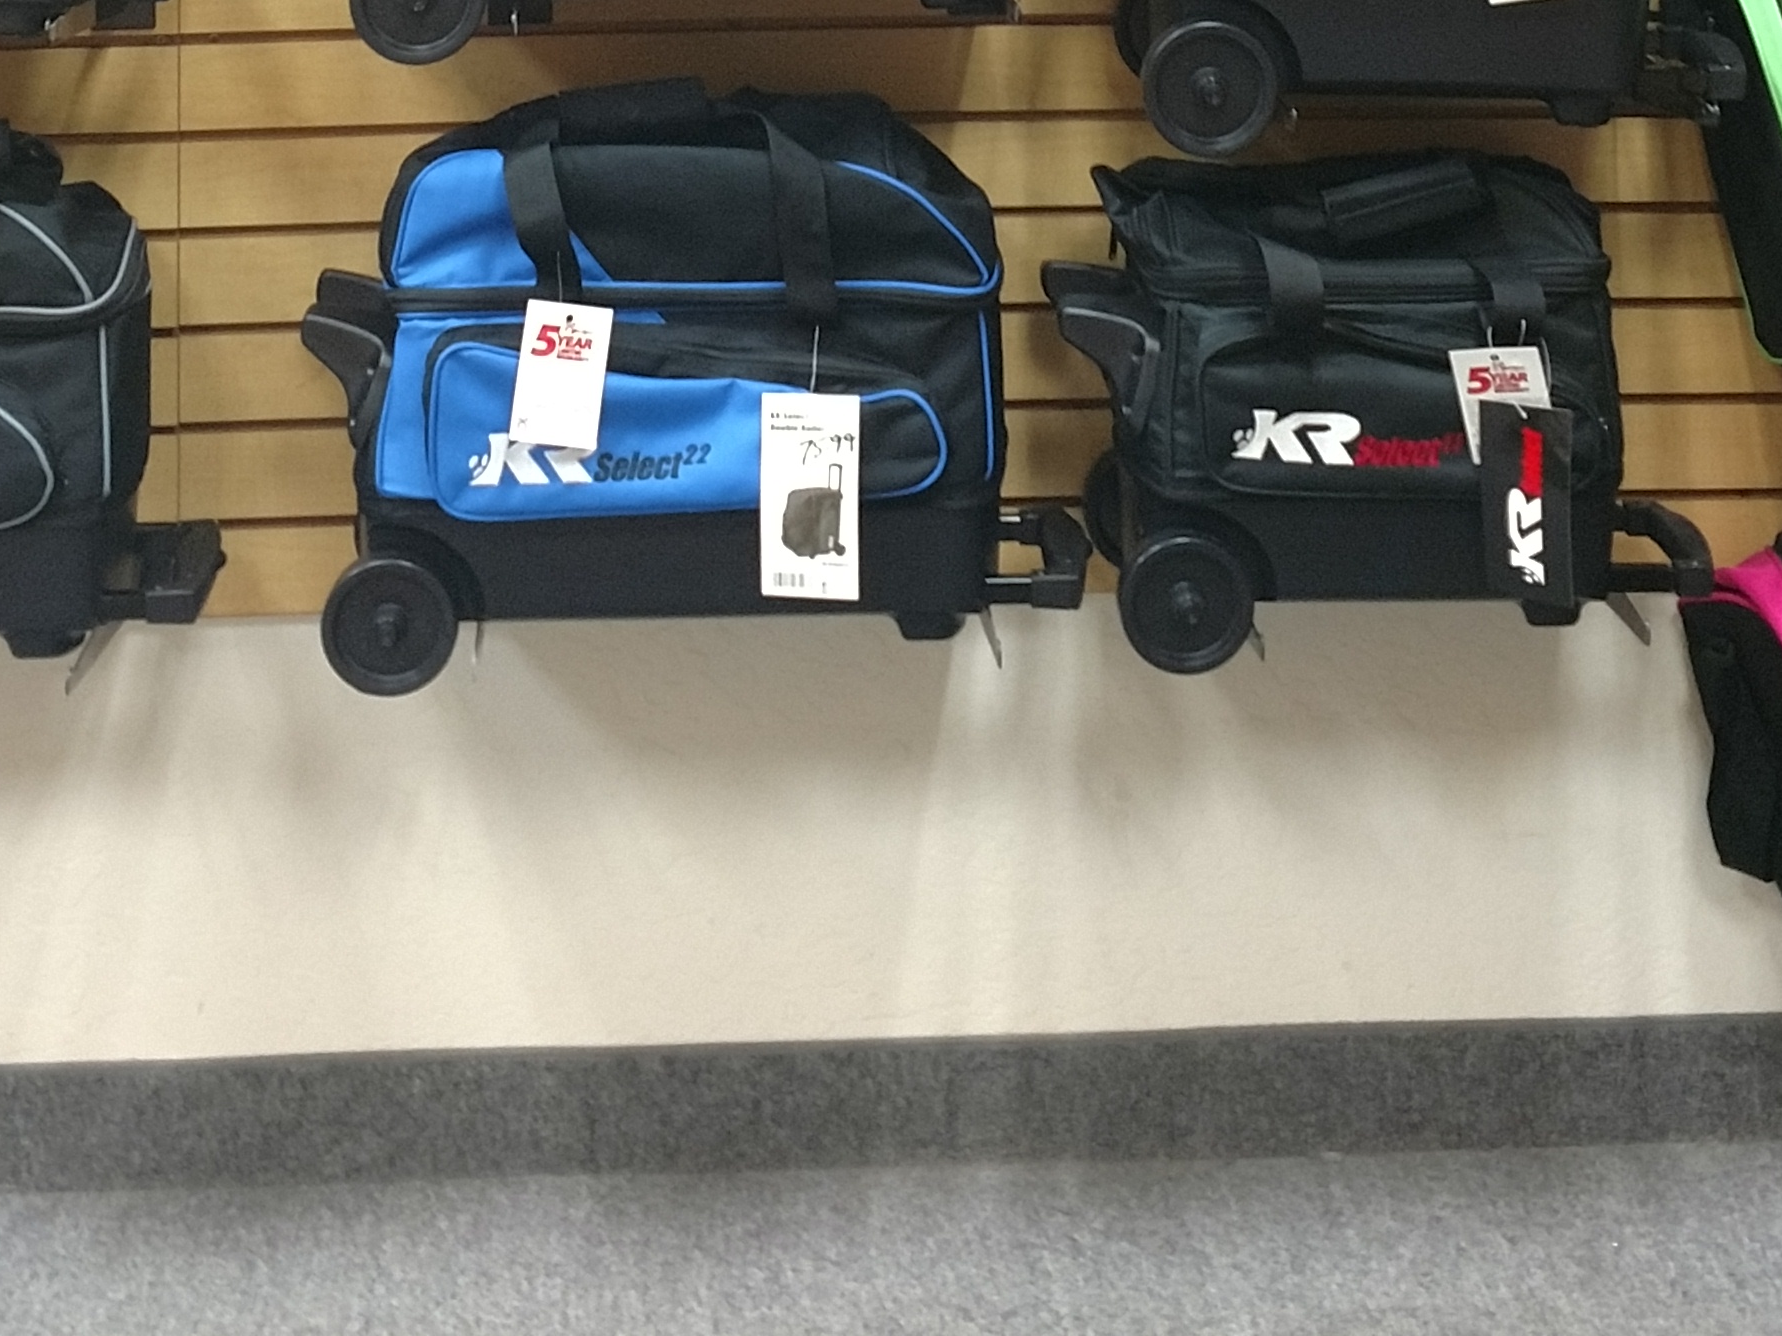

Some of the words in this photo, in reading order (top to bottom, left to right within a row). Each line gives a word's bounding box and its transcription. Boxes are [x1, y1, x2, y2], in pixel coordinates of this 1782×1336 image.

[530, 325, 561, 356] 5
[558, 335, 593, 350] YEAR
[1466, 366, 1492, 395] 5
[1489, 371, 1529, 384] YEAR
[1231, 408, 1362, 466] KR
